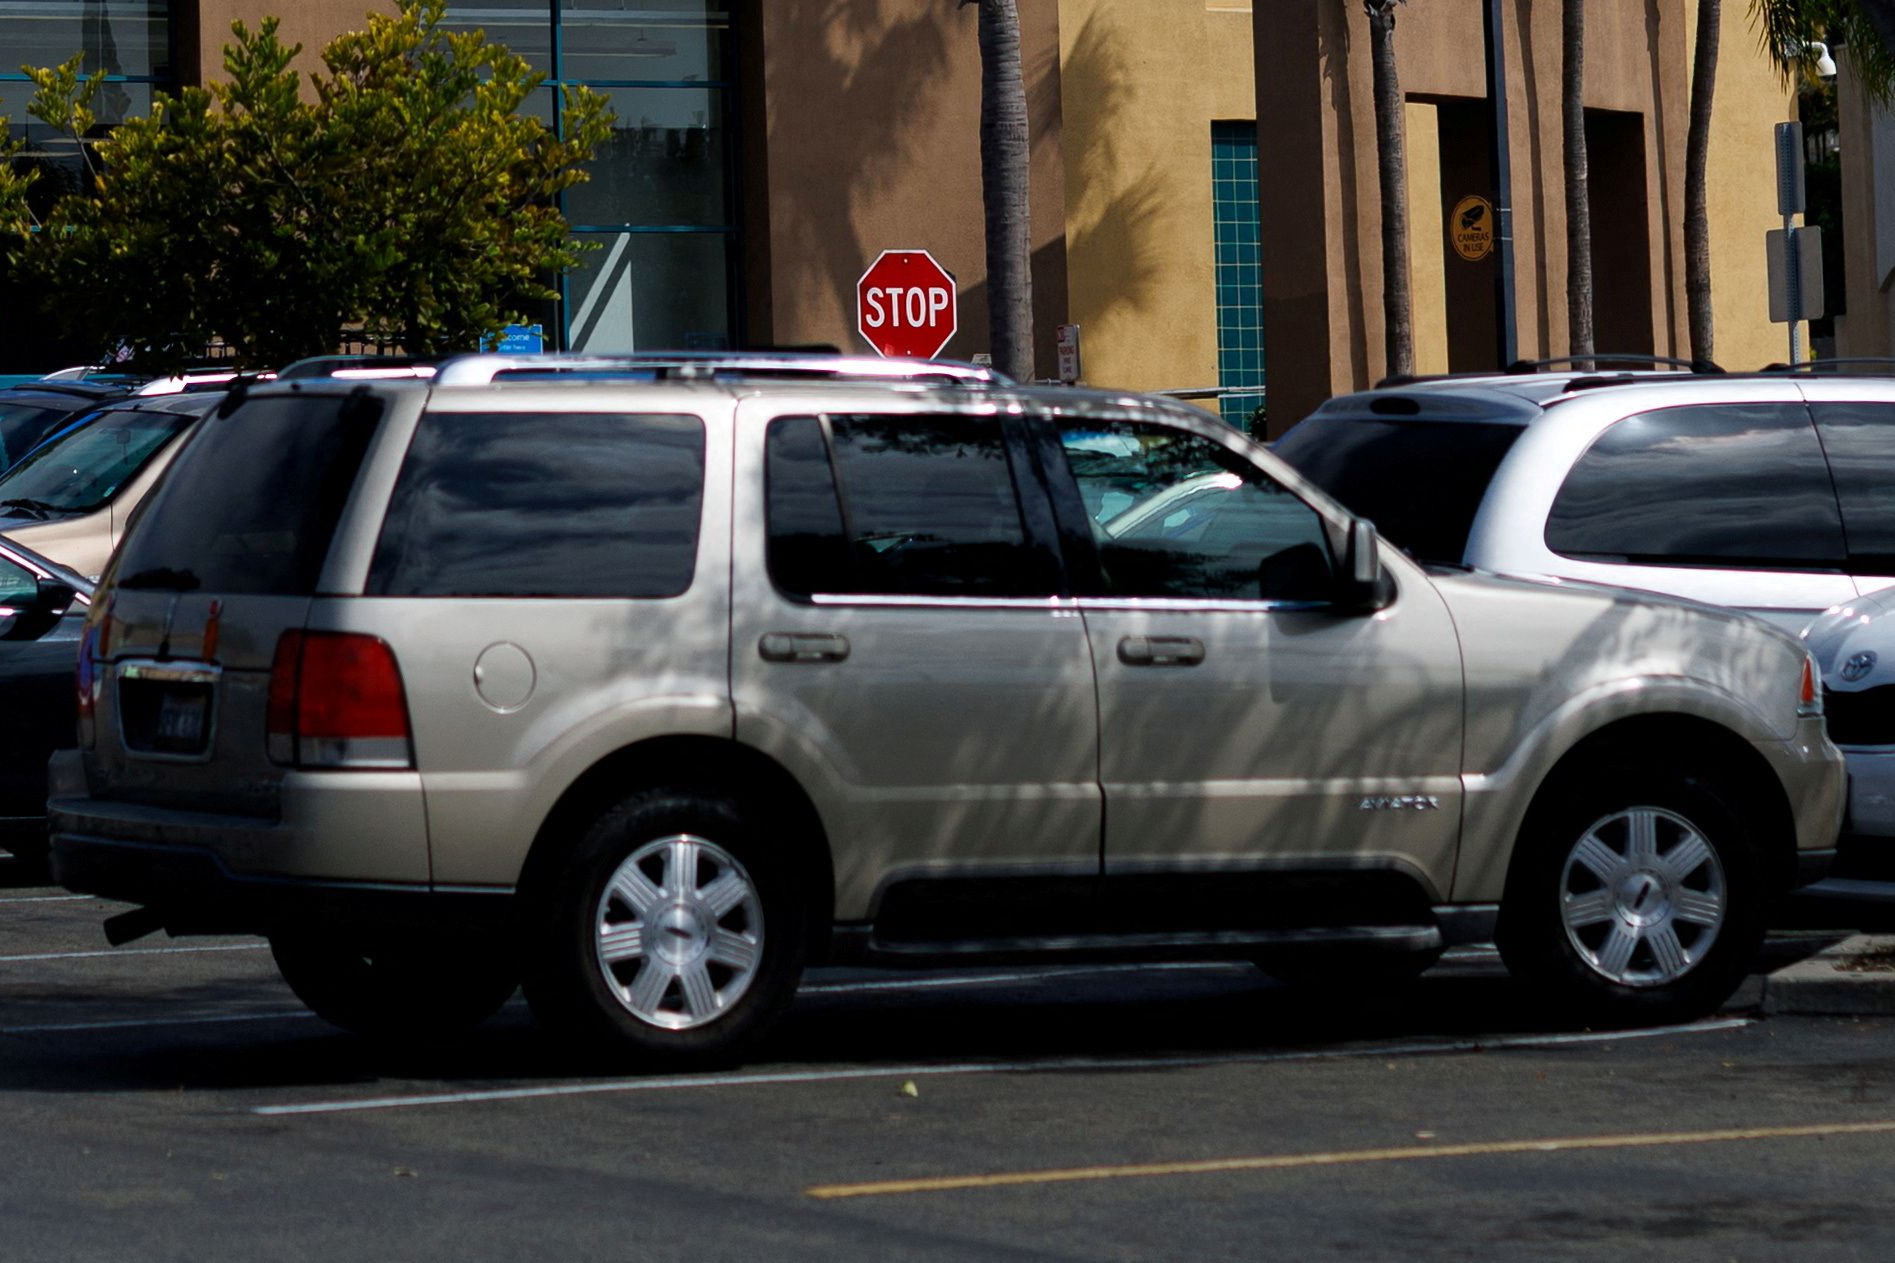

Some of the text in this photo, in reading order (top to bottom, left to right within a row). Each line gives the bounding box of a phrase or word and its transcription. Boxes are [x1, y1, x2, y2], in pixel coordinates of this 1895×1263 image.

[1457, 232, 1490, 243] CAMERAS
[1463, 242, 1484, 253] IN USE
[865, 287, 949, 328] STOP
[507, 334, 530, 342] come
